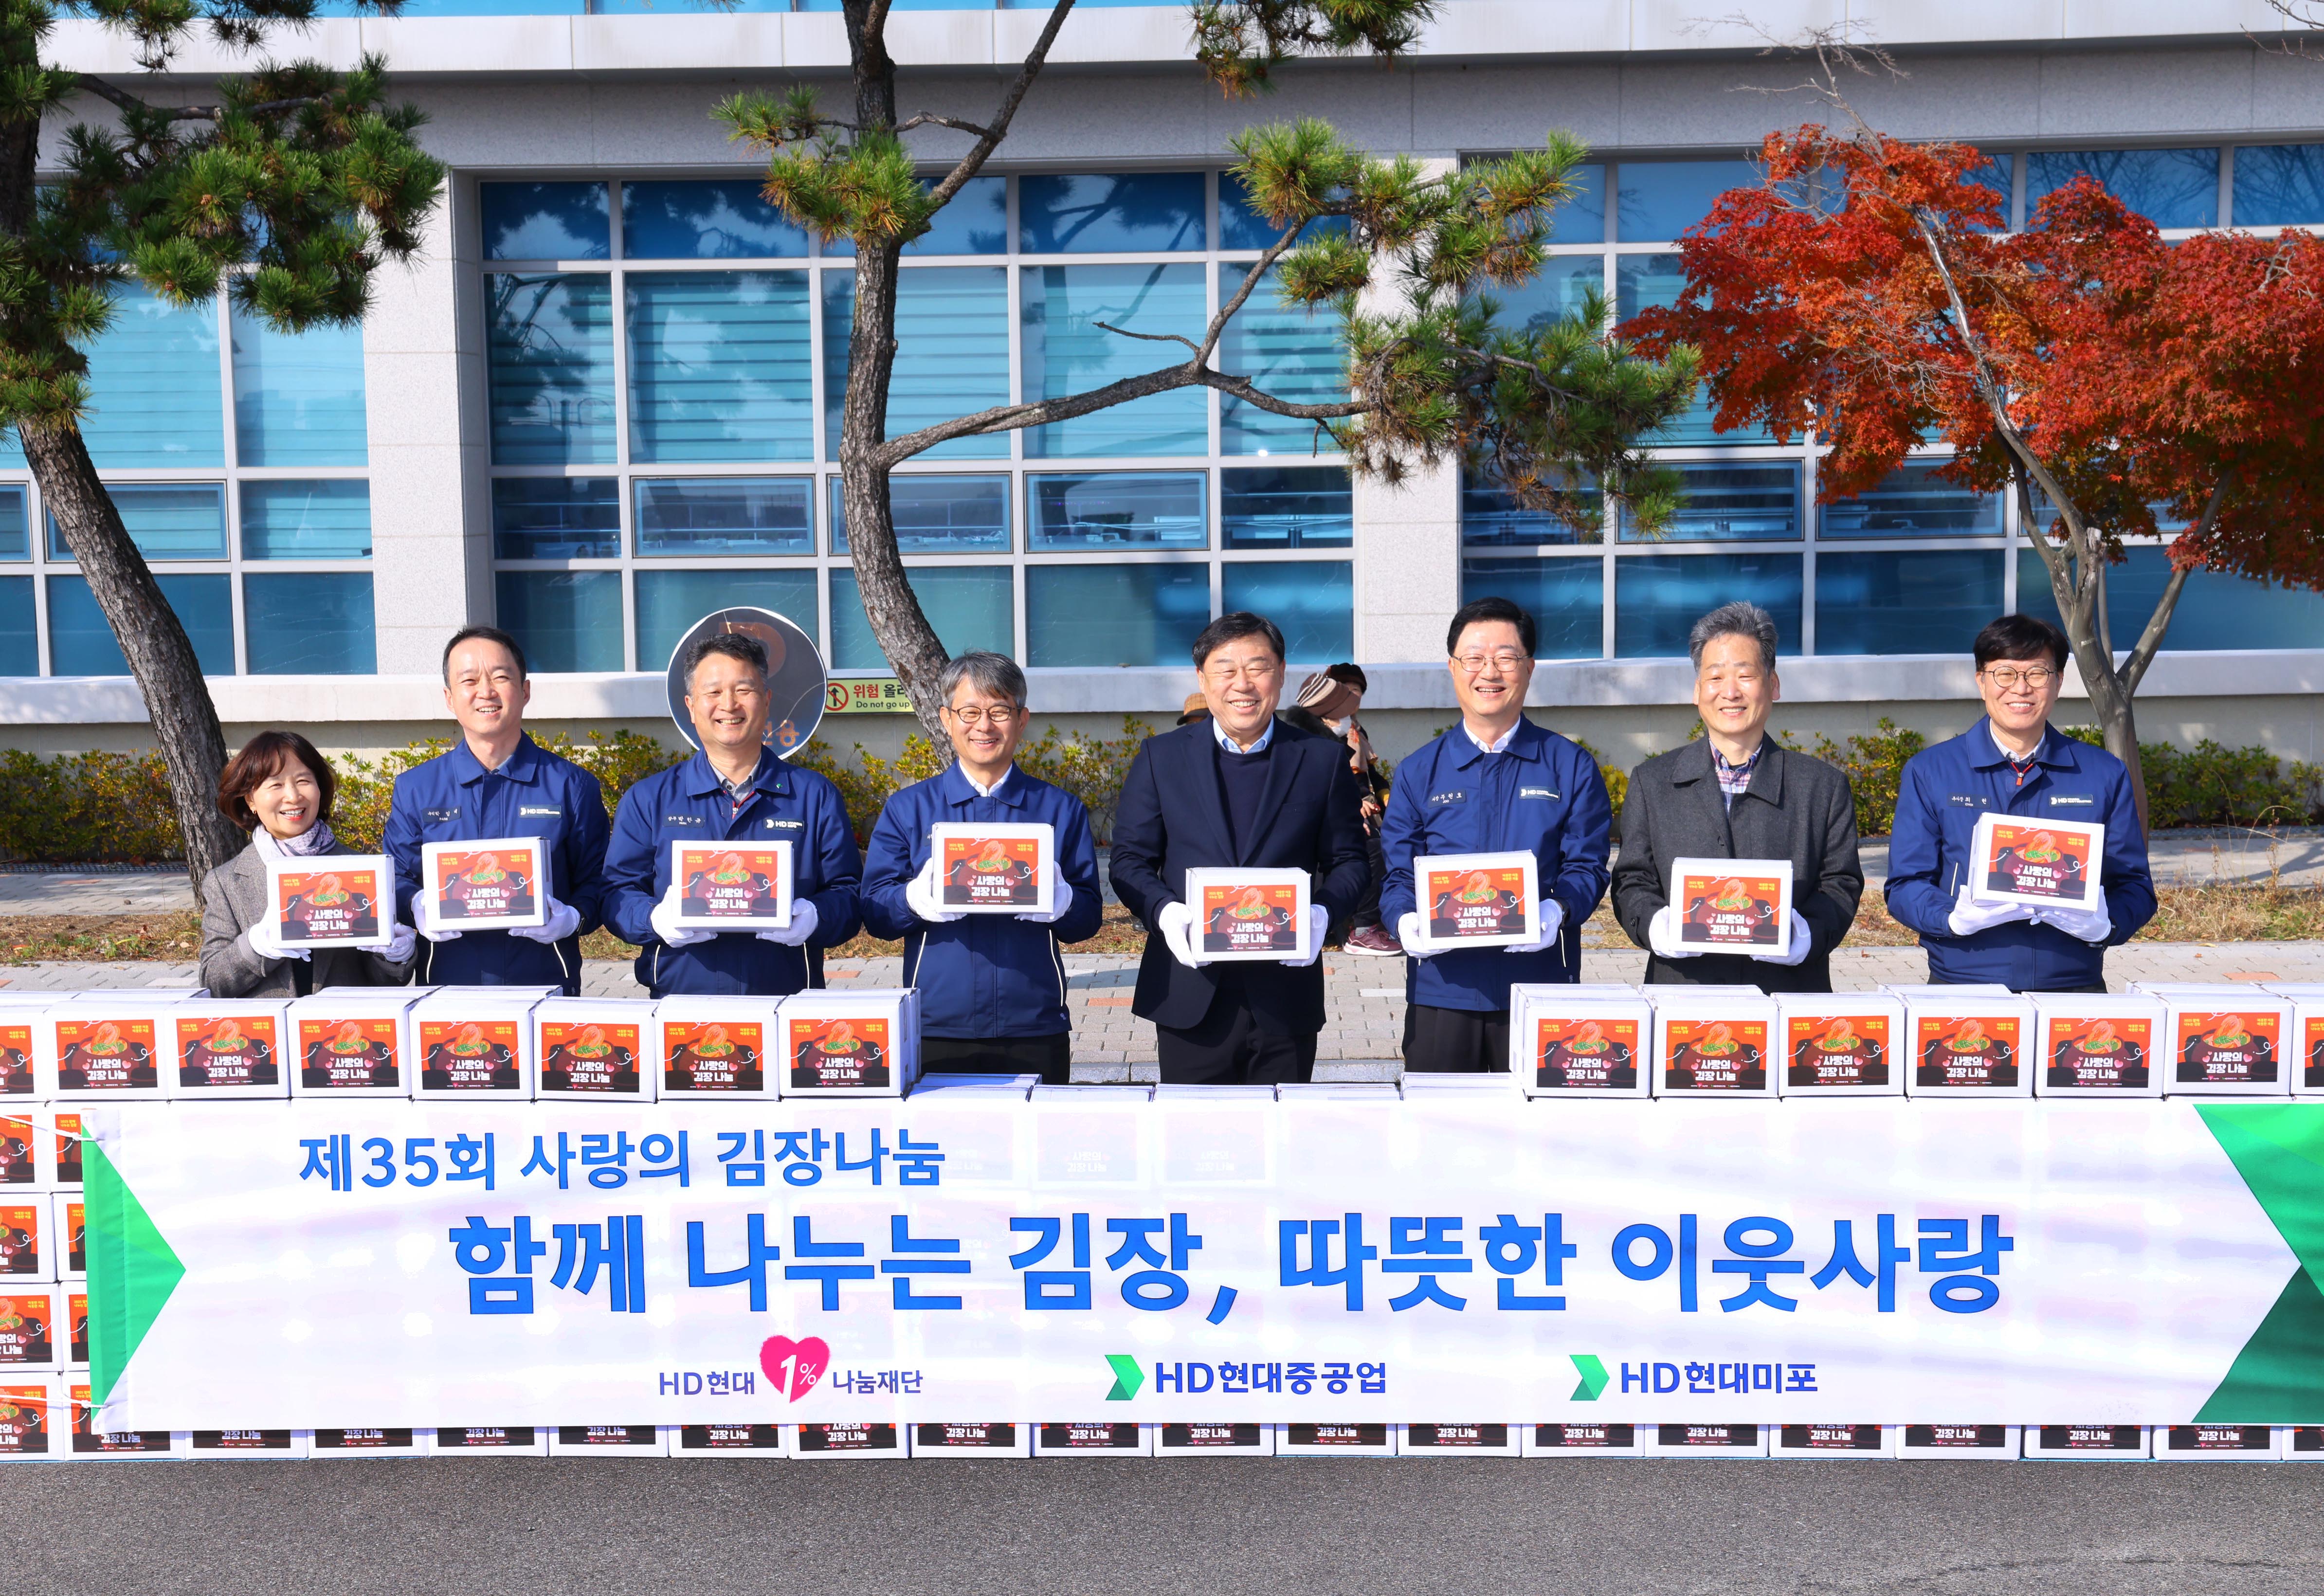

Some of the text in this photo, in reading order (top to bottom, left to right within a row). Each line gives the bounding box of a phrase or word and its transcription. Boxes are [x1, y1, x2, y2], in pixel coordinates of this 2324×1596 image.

[853, 684, 879, 698] 위험
[2023, 865, 2052, 877] 사랑의
[977, 876, 1005, 885] 사랑의
[2016, 875, 2056, 889] 김장 나눔
[472, 888, 500, 898] 사랑의
[715, 888, 743, 897] 사랑의
[971, 887, 1010, 896] 김장 나눔
[467, 899, 506, 909] 김장 나눔
[709, 899, 748, 908] 김장 나눔
[314, 909, 343, 919] 사랑의
[1463, 907, 1491, 917] 사랑의
[1458, 917, 1497, 928] 김장 나눔
[1716, 914, 1744, 924] 사랑의
[309, 920, 349, 931] 김장 나눔
[1236, 923, 1264, 932] 사랑의
[1710, 925, 1749, 935] 김장 나눔
[1231, 934, 1269, 943] 김장 나눔
[212, 1056, 242, 1066] 사랑의
[1823, 1055, 1853, 1065] 사랑의
[1953, 1056, 1982, 1066] 사랑의
[2083, 1057, 2113, 1067] 사랑의
[2213, 1052, 2242, 1062] 사랑의
[91, 1059, 122, 1069] 사랑의
[334, 1058, 364, 1068] 사랑의
[455, 1060, 485, 1069] 사랑의
[576, 1061, 605, 1071] 사랑의
[699, 1061, 728, 1070] 사랑의
[825, 1058, 854, 1067] 사랑의
[1572, 1058, 1601, 1068] 사랑의
[1701, 1060, 1731, 1070] 사랑의
[208, 1067, 249, 1077] 김장 나눔
[1817, 1067, 1858, 1077] 김장 나눔
[1947, 1068, 1988, 1077] 김장 나눔
[2207, 1064, 2247, 1073] 김장 나눔
[87, 1070, 127, 1080] 김장 나눔
[330, 1069, 370, 1079] 김장 나눔
[450, 1071, 490, 1081] 김장 나눔
[570, 1072, 610, 1083] 김장 나눔
[693, 1072, 734, 1082] 김장 나눔
[819, 1069, 860, 1079] 김장 나눔
[1566, 1070, 1607, 1079] 김장 나눔
[1695, 1071, 1736, 1081] 김장 나눔
[2077, 1069, 2118, 1079] 김장 나눔
[300, 1128, 945, 1192] 제35회 사랑의 김장나눔
[449, 1213, 2014, 1325] 함께 나누는 김장, 따뜻한 이웃사랑
[660, 1354, 923, 1401] HD현대 1% 나눔재단
[1156, 1361, 1386, 1395] HD현대중공업
[1621, 1361, 1818, 1394] HD현대미포
[710, 1430, 749, 1439] 김장 나눔
[946, 1428, 986, 1437] 김장 나눔
[1070, 1430, 1109, 1439] 김장 나눔
[1438, 1428, 1477, 1437] 김장 나눔
[1564, 1429, 1604, 1438] 김장 나눔
[1811, 1431, 1851, 1440] 김장 나눔
[1935, 1429, 1975, 1438] 김장 나눔
[2070, 1431, 2110, 1440] 김장 나눔
[2198, 1431, 2239, 1441] 김장 나눔
